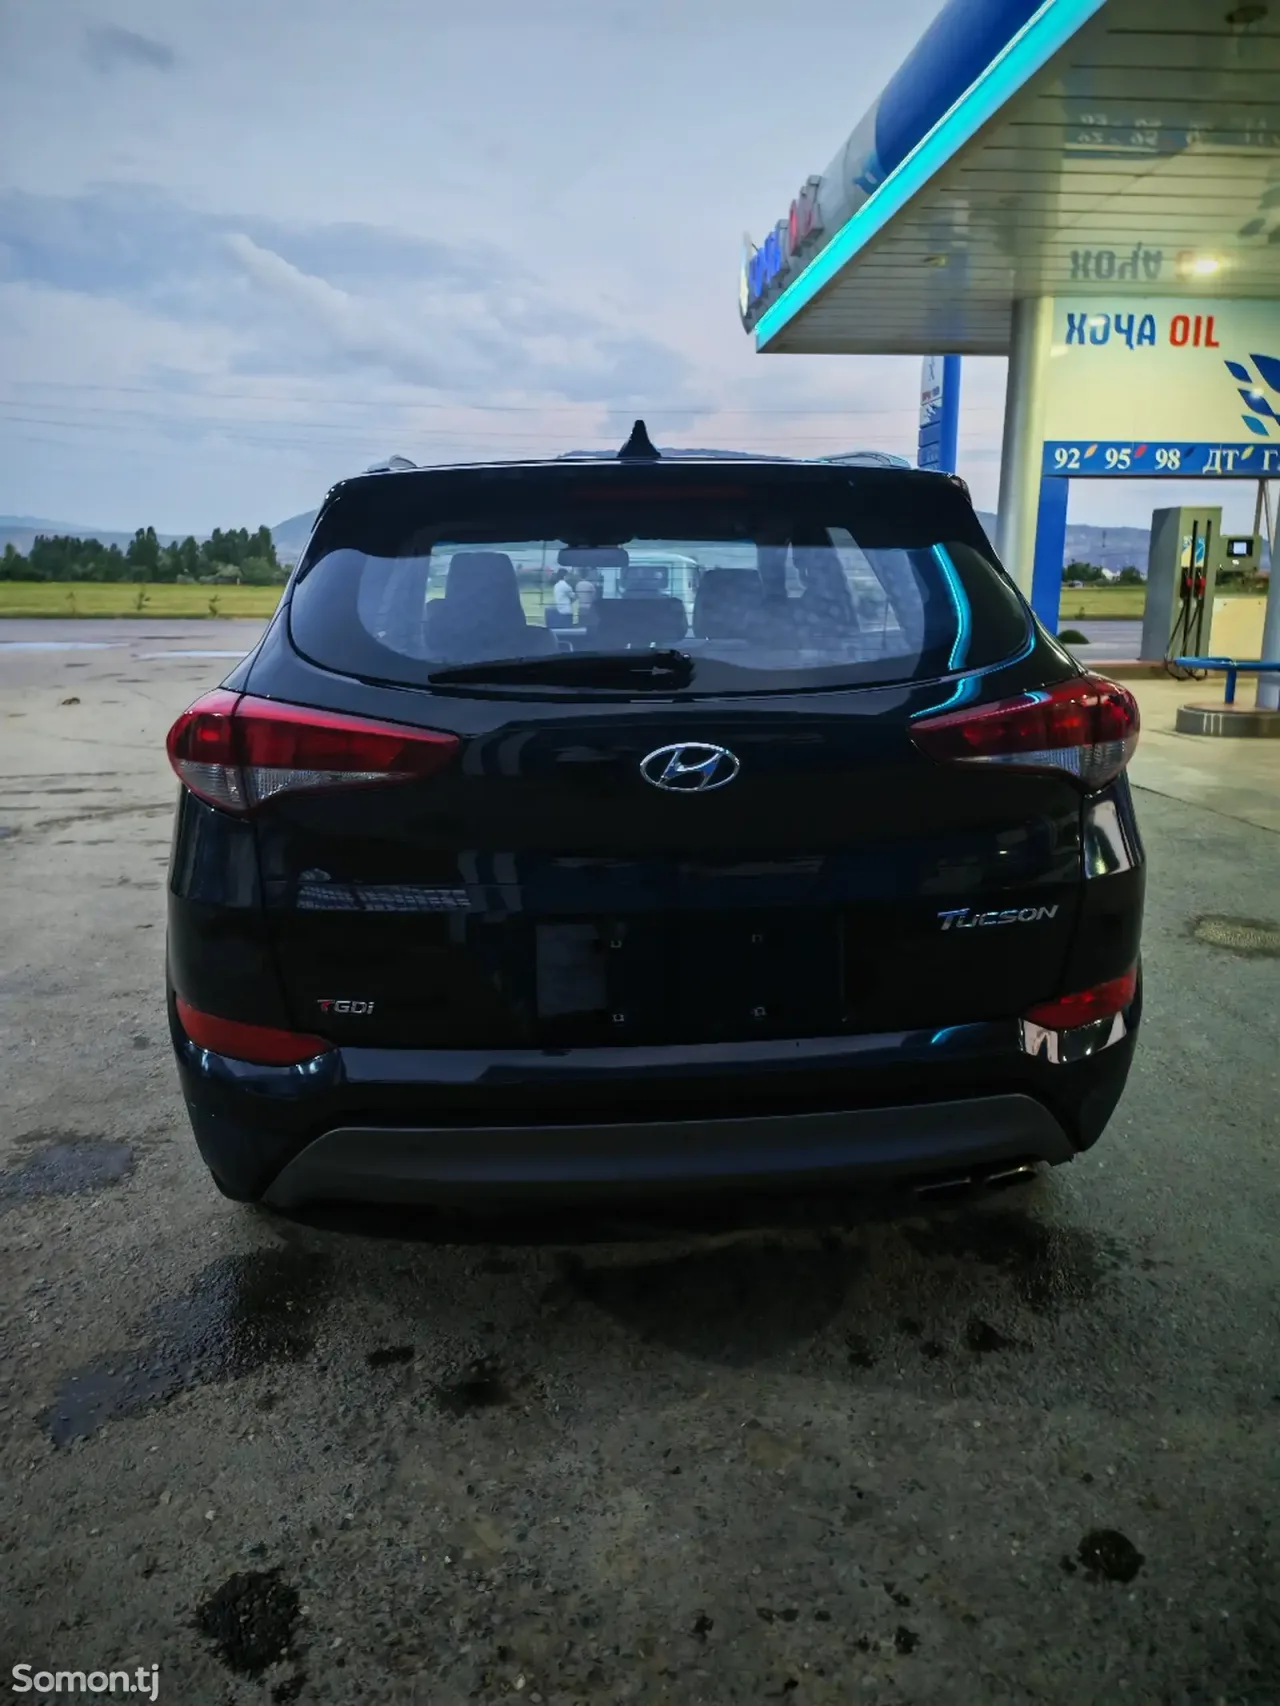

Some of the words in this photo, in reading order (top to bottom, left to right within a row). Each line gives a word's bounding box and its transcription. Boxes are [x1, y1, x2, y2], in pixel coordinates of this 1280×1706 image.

[1169, 314, 1219, 348] OIL
[1054, 447, 1080, 470] 92
[1105, 447, 1131, 470] 95
[1154, 448, 1180, 471] 98
[1202, 449, 1239, 475] ДТ
[1261, 449, 1280, 472] Г
